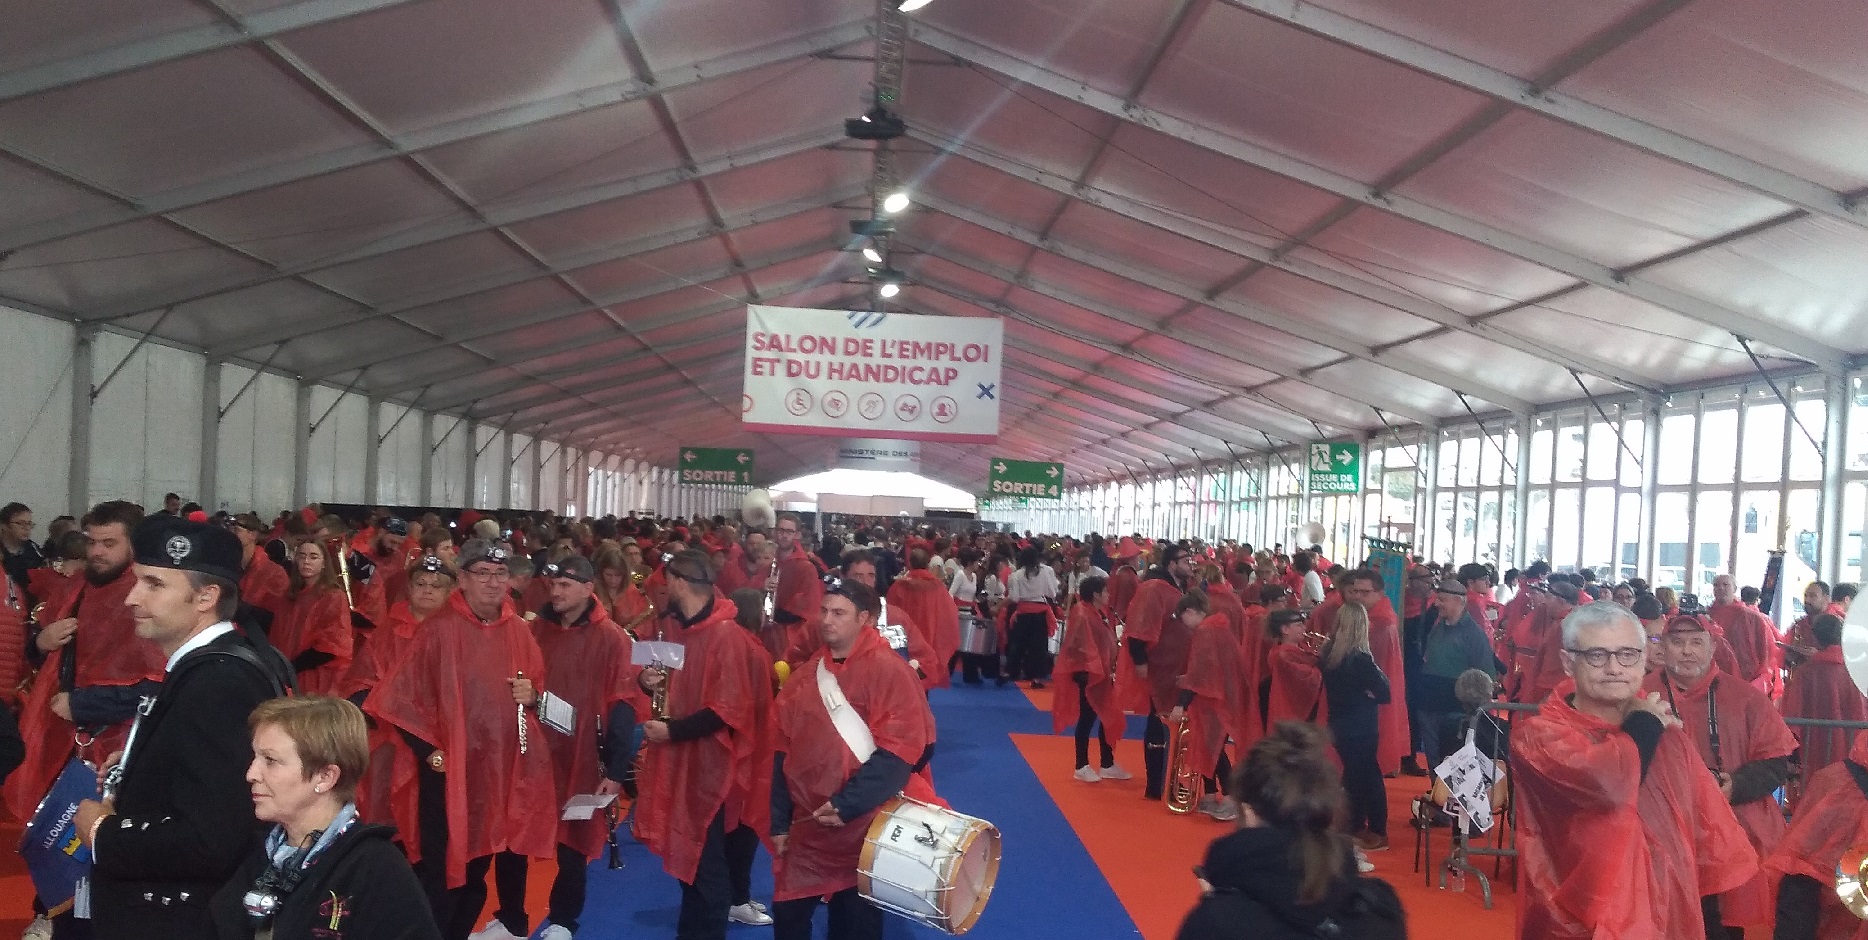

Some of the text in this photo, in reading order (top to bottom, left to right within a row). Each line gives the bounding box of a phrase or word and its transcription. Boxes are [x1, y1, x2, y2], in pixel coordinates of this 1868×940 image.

[752, 331, 989, 363] SALON DE L'EMPLOI
[751, 357, 958, 386] ET DU HANDICAP
[683, 470, 749, 482] SORTIE 1
[1311, 474, 1353, 482] ISSUE DE
[992, 480, 1058, 497] SORTIE 4
[1310, 482, 1356, 491] SECOURS
